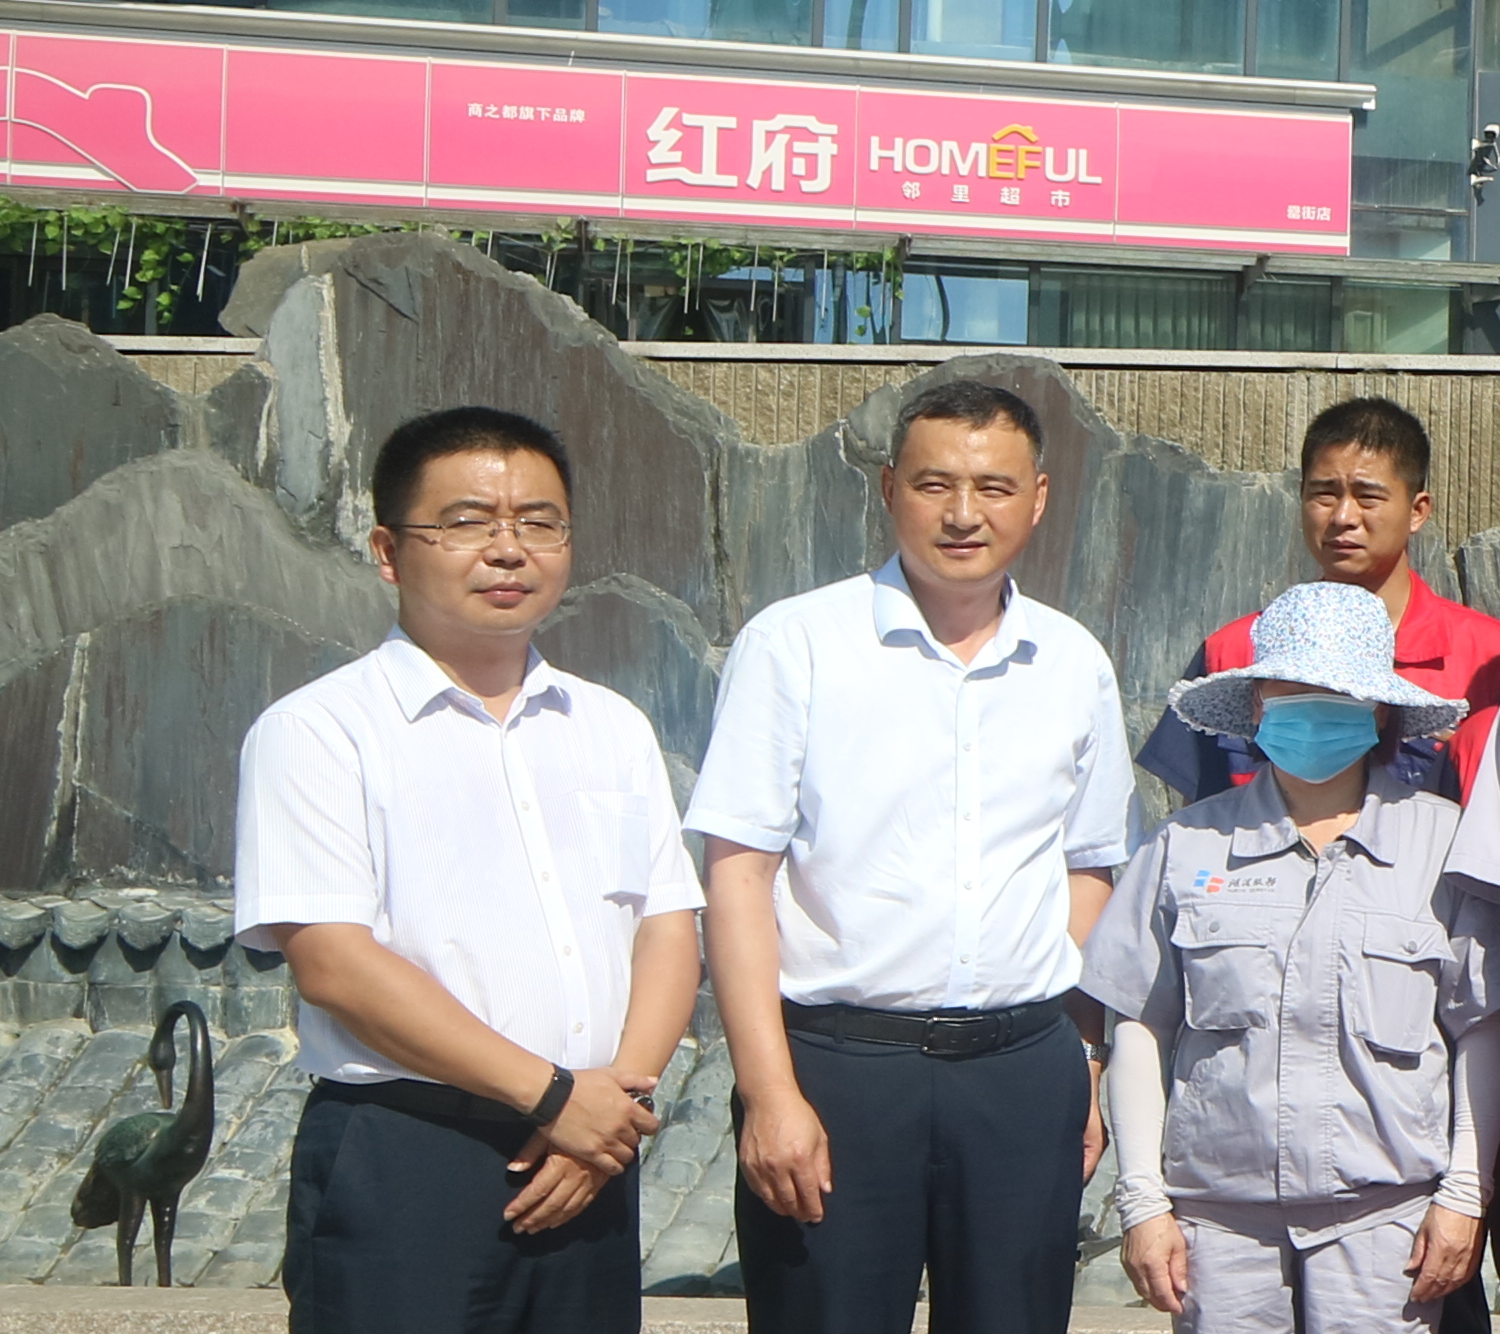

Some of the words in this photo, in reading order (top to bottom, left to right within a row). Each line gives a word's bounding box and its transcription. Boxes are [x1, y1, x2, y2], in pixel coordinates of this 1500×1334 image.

[467, 101, 586, 124] 商之都旗下品牌
[645, 106, 839, 194] 红府
[868, 135, 1103, 185] HOMEFUL
[901, 181, 1072, 208] 邻里超市
